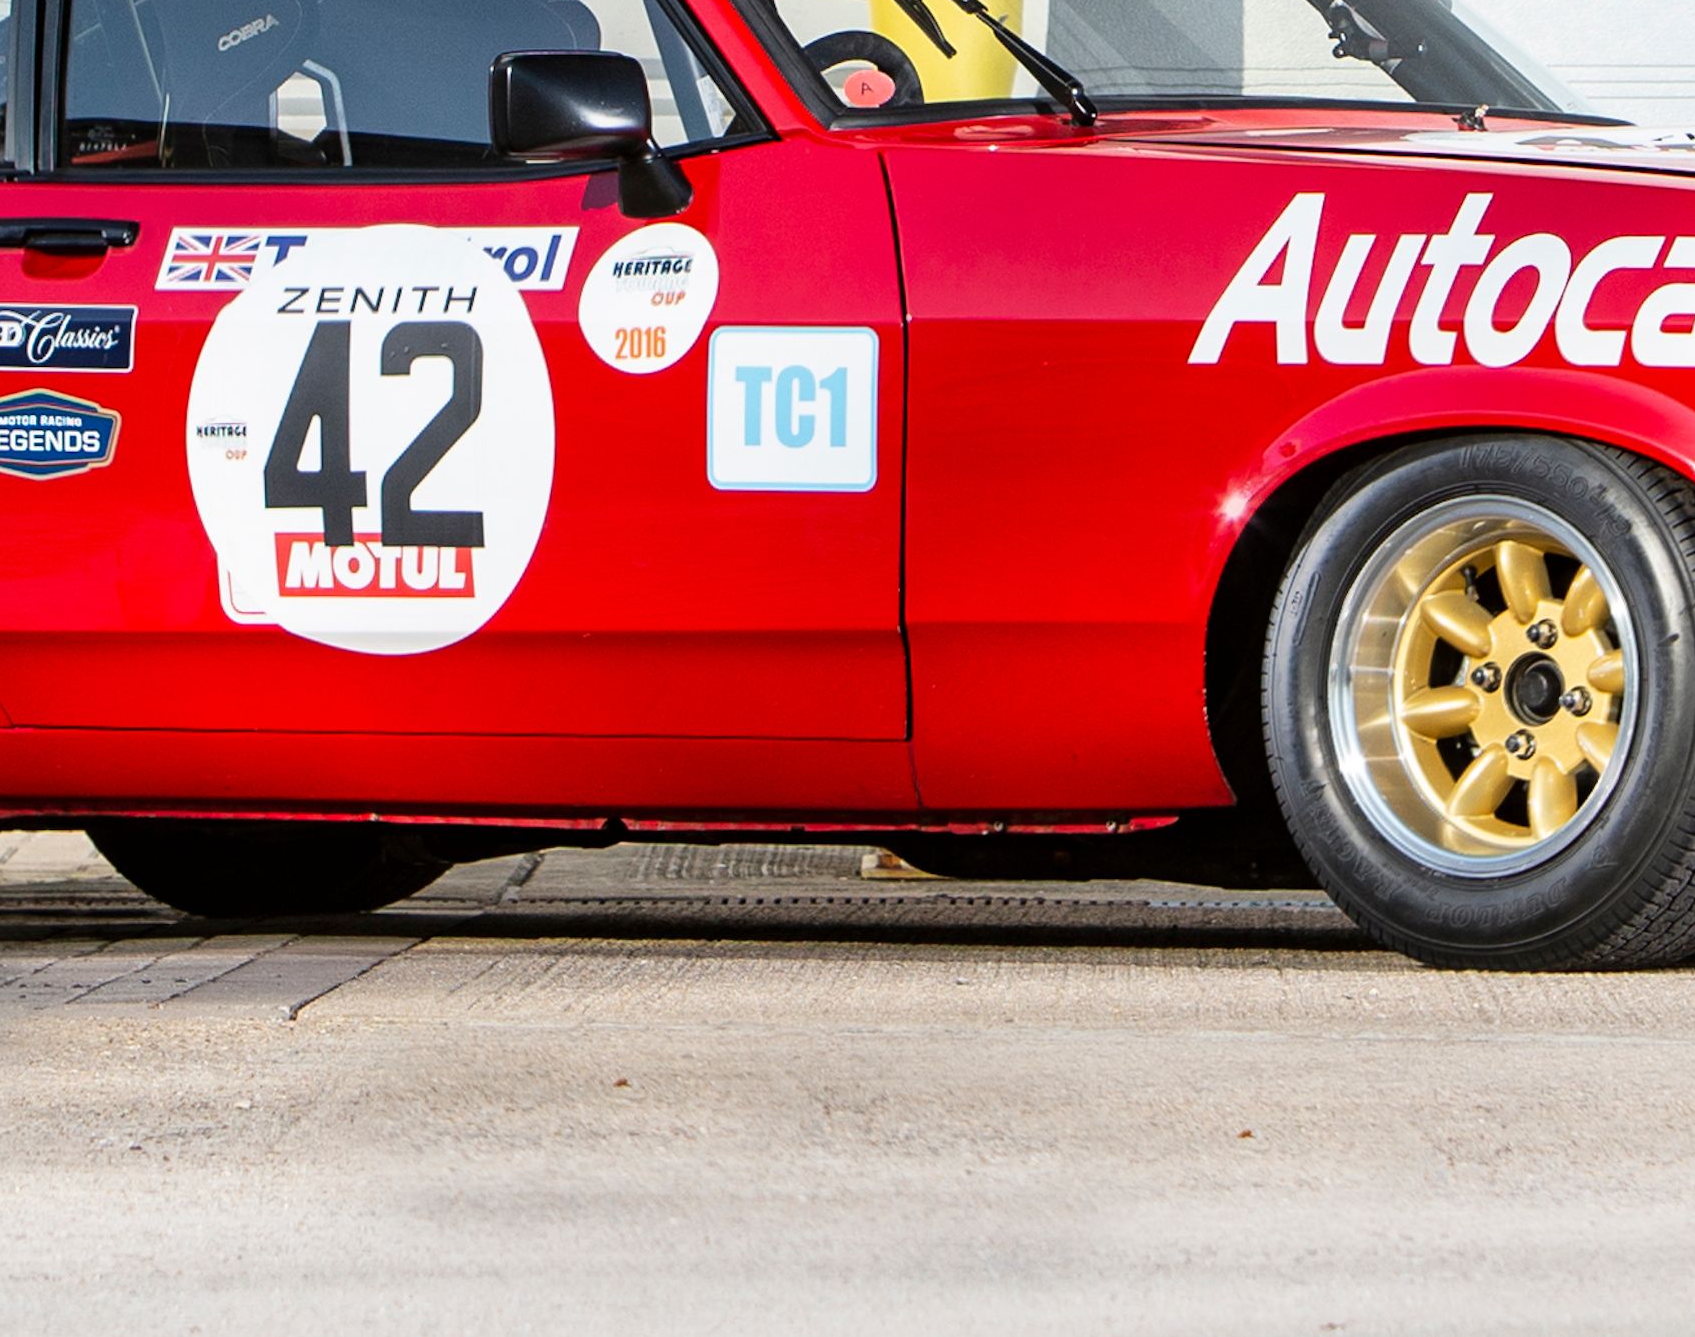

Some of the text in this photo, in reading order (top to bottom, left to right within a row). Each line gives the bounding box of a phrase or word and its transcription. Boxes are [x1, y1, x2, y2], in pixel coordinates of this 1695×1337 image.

[218, 13, 279, 51] COBRA
[612, 258, 693, 278] HERITAGE
[277, 286, 478, 314] ZENITH
[615, 325, 667, 360] 2016
[40, 416, 82, 427] RACING
[735, 364, 848, 448] TC1
[196, 425, 247, 438] HERITAGE
[264, 320, 485, 548] 42
[284, 531, 467, 591] MOTUL
